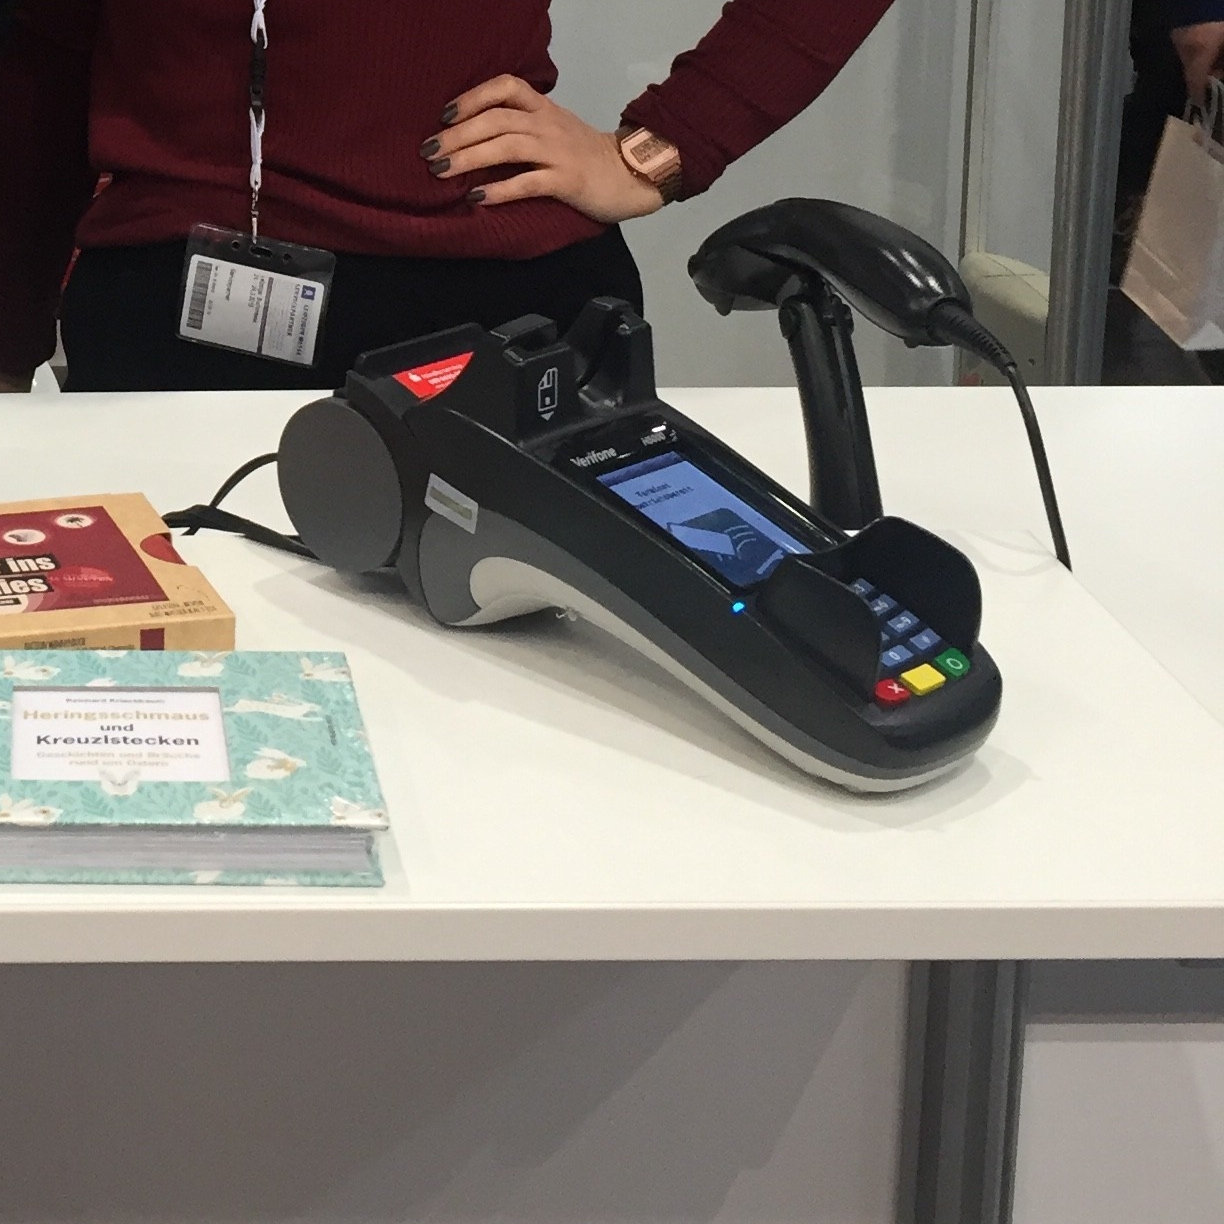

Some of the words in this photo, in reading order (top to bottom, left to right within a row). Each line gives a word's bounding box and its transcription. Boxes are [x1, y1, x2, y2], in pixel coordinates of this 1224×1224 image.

[569, 447, 618, 467] Verifone
[5, 556, 56, 572] ins
[23, 710, 210, 721] Heringsschmaus
[100, 724, 134, 732] und
[36, 735, 200, 746] Kreuzlstecken
